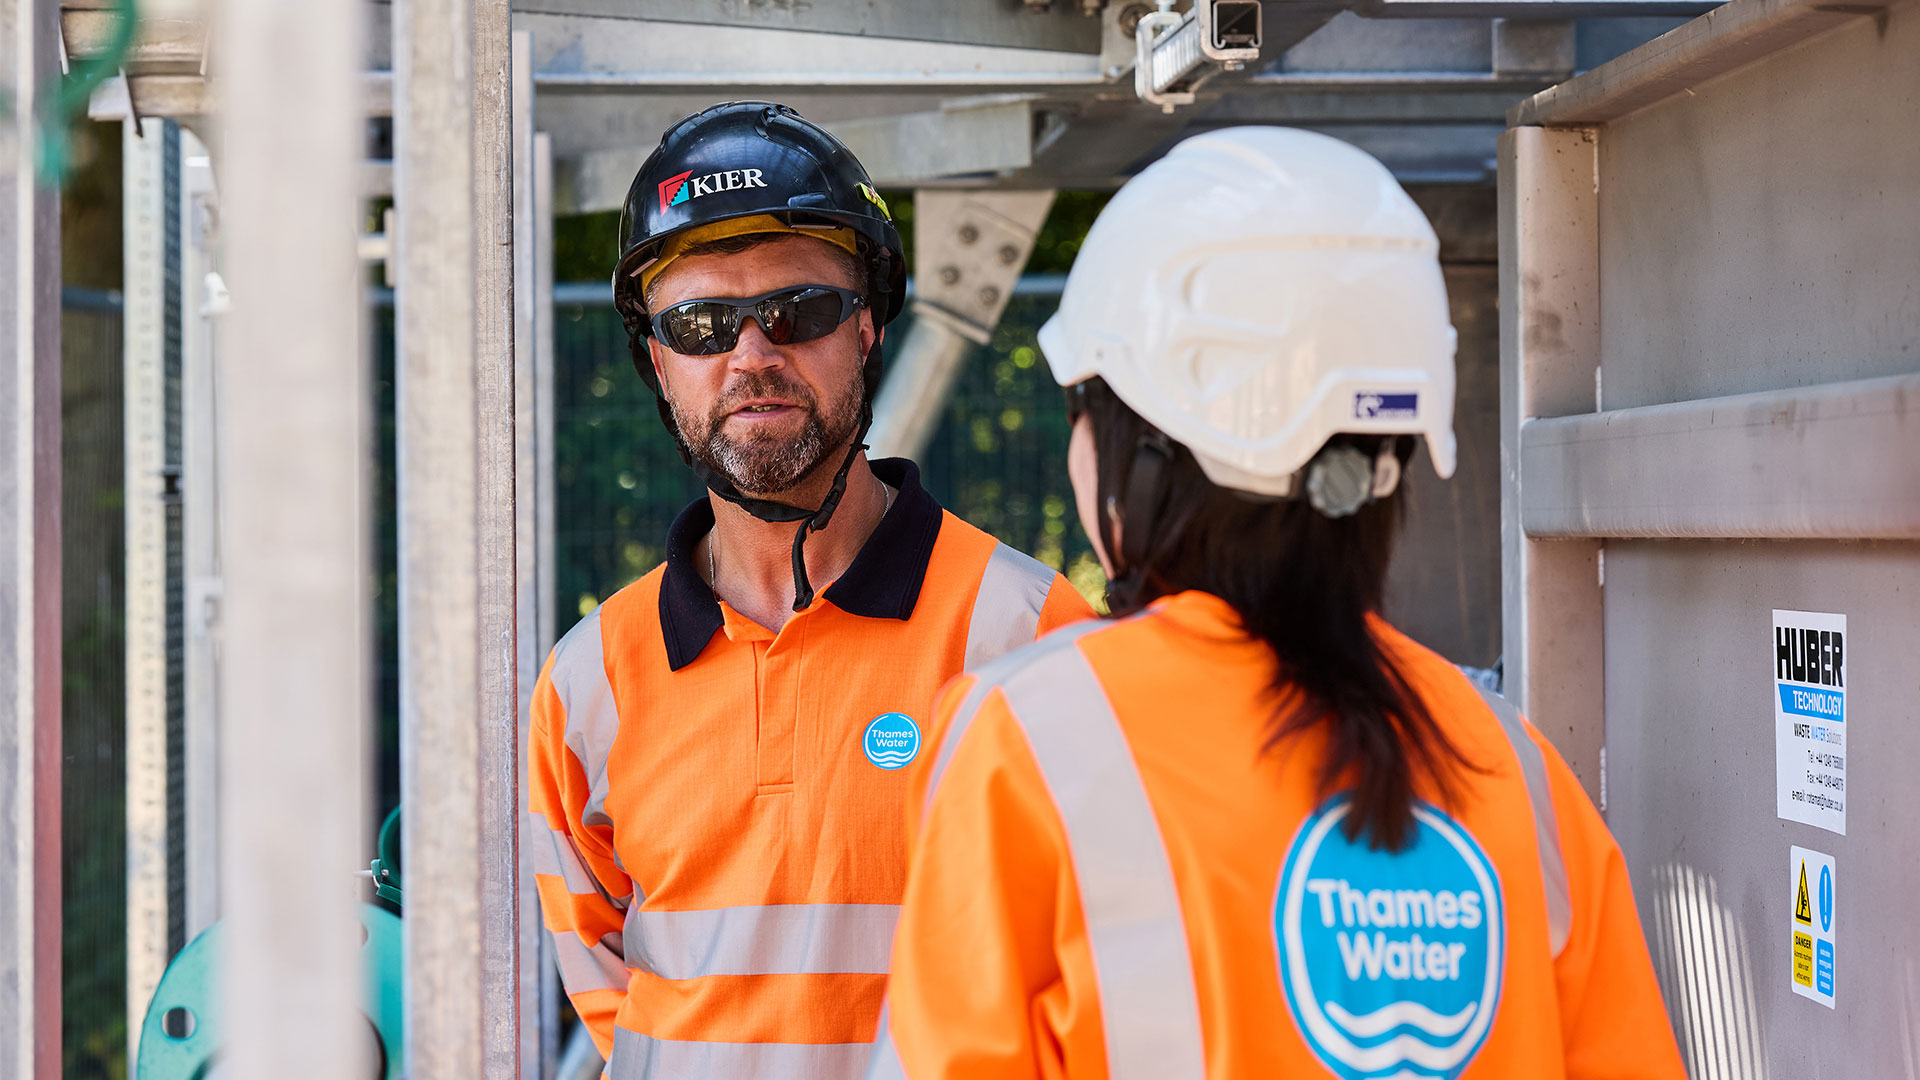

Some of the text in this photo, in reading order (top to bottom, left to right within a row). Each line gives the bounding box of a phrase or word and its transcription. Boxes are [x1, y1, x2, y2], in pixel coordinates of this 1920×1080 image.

[691, 168, 768, 198] KIER
[1776, 627, 1843, 687] HUBER
[1793, 690, 1842, 716] TECHNOLOGY
[872, 729, 914, 738] Thames
[876, 738, 909, 747] Water
[1793, 723, 1810, 739] WASTE
[1306, 878, 1482, 929] Thames
[1795, 935, 1811, 950] DANGER
[1336, 931, 1466, 981] Water
